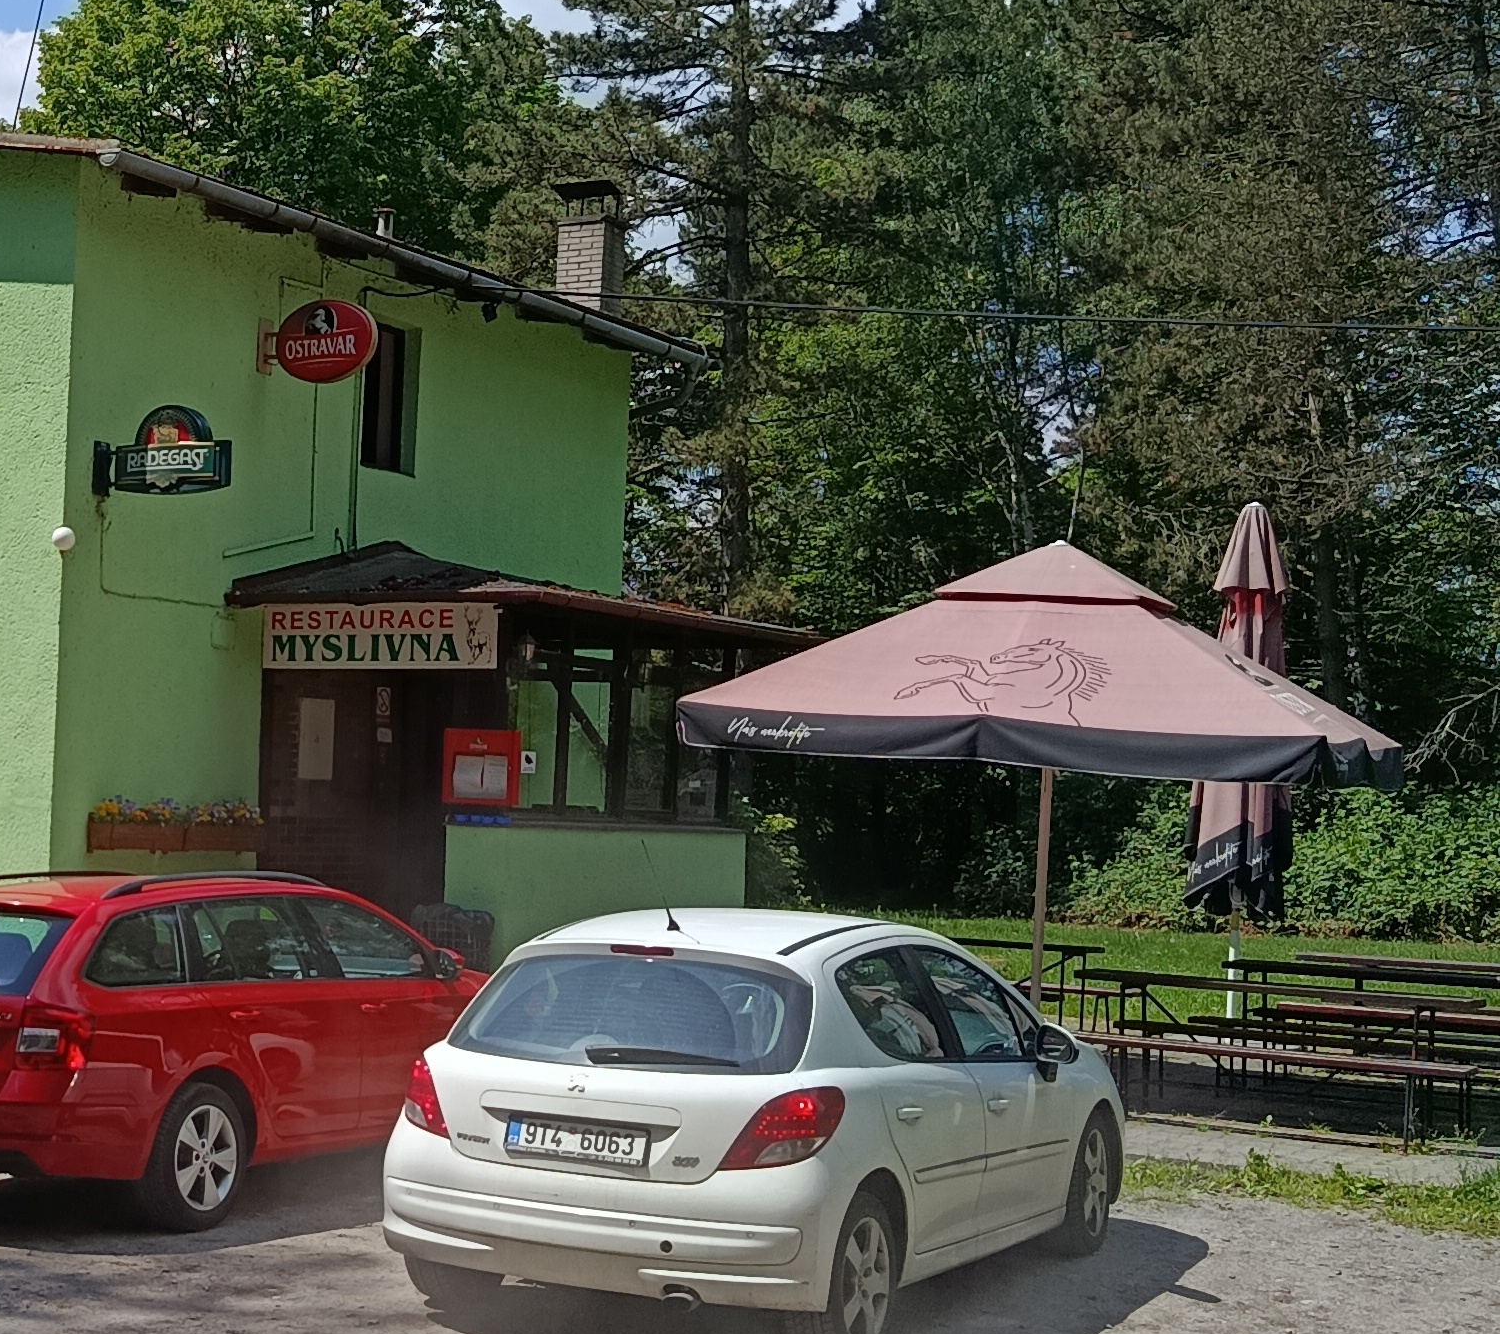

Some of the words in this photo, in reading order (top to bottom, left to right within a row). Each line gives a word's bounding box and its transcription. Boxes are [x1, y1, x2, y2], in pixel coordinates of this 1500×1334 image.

[285, 334, 356, 360] OSTRAVAR
[126, 448, 209, 472] RADEGAST
[271, 608, 454, 630] RESTAURACE
[271, 633, 460, 662] MYSLIVNA
[524, 1122, 562, 1148] 9T4
[580, 1127, 635, 1156] 6063
